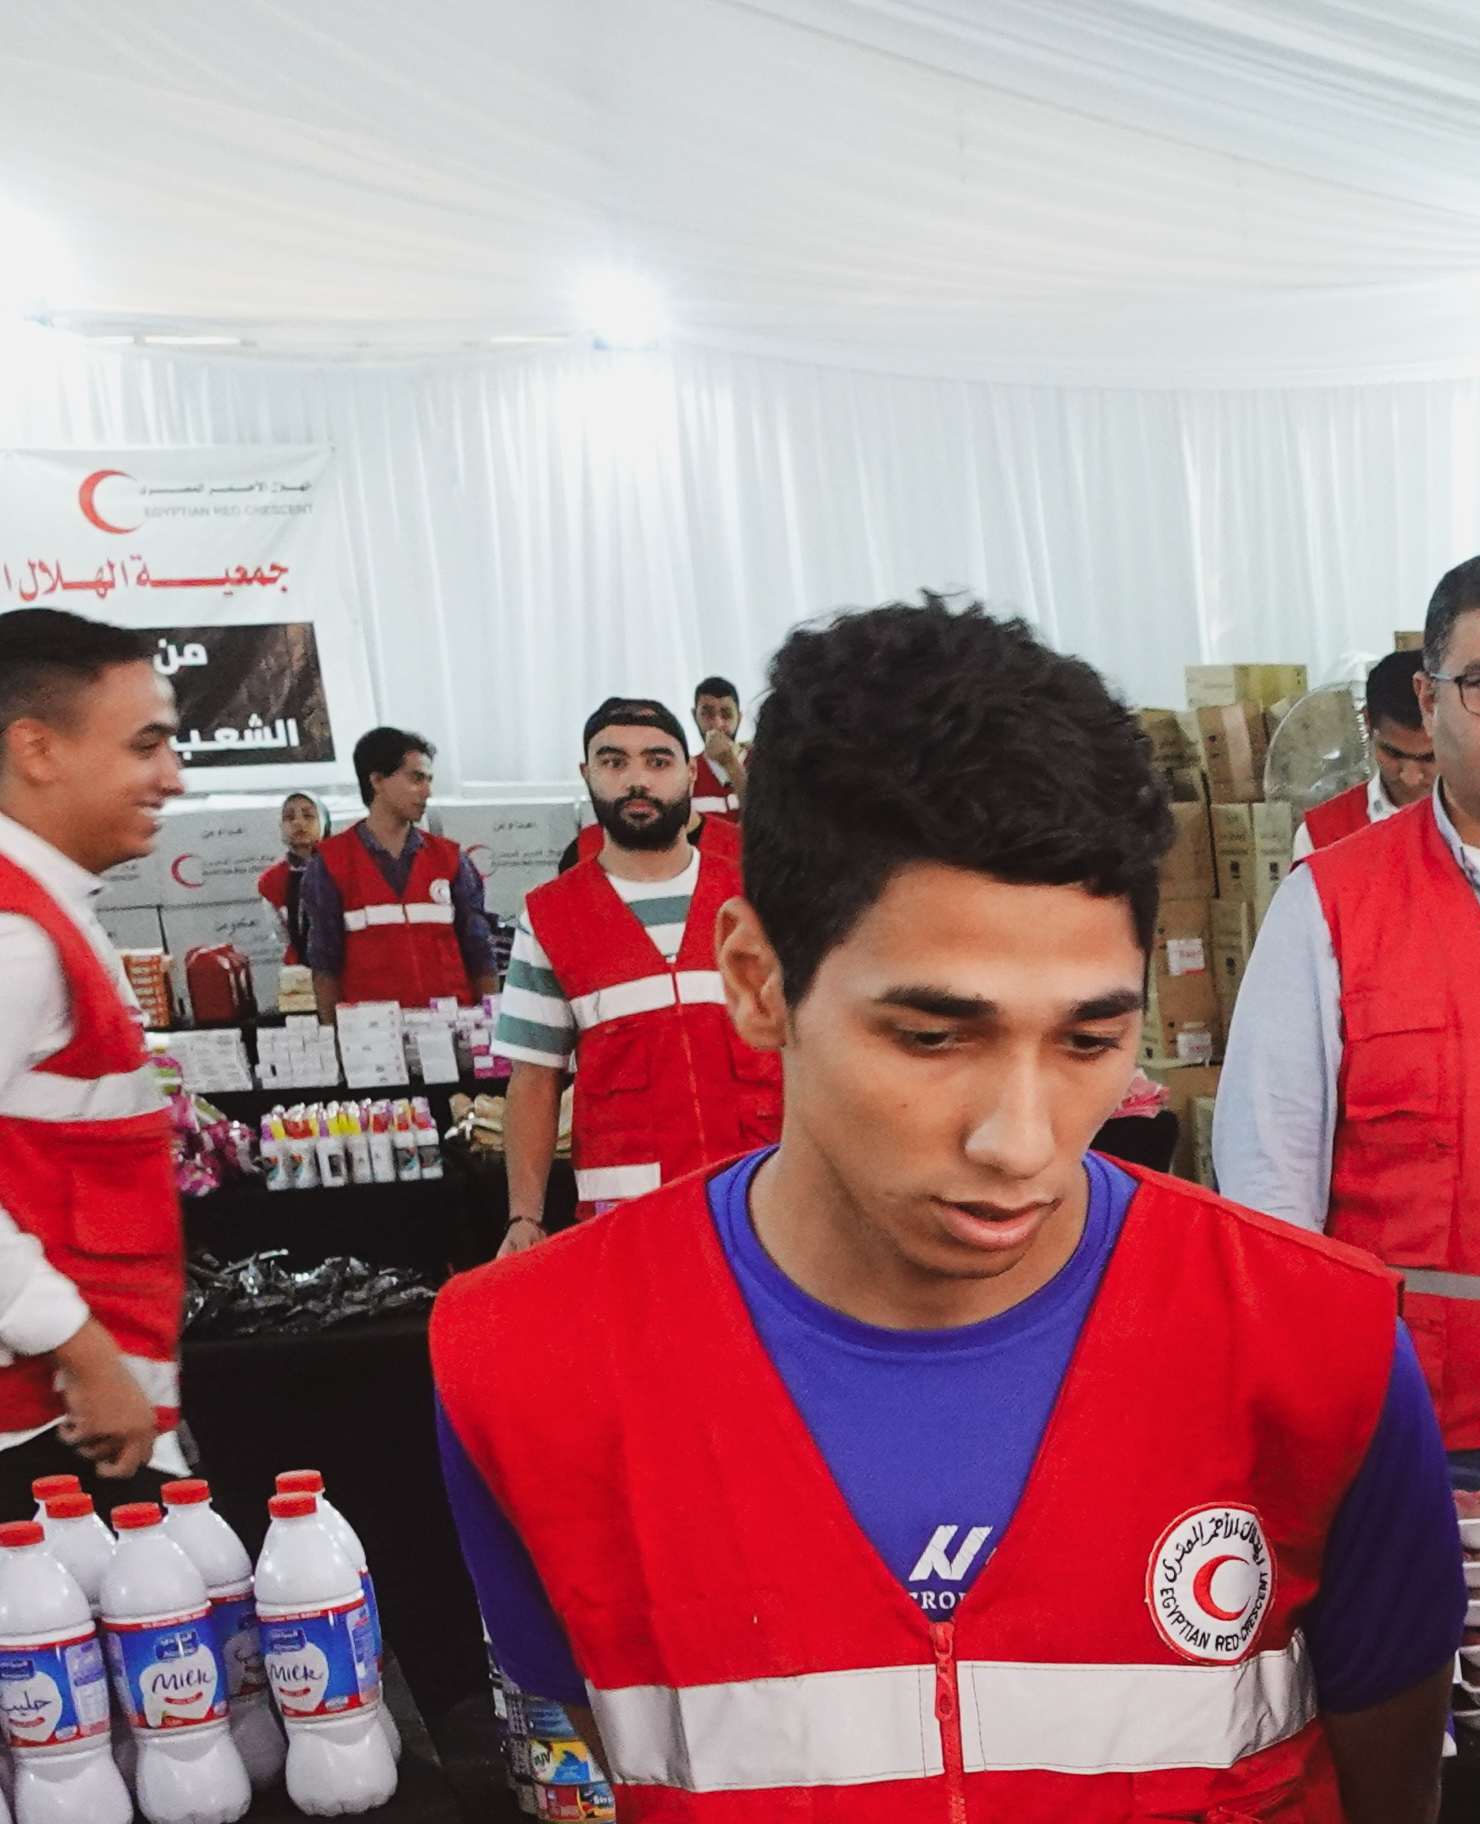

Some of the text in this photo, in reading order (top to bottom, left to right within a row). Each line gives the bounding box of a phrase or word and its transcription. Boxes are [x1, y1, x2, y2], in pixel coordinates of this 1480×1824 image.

[19, 552, 129, 602] الهلال
[153, 638, 208, 676] من
[1160, 1572, 1269, 1652] EGYPTIAN RED CRESCENT
